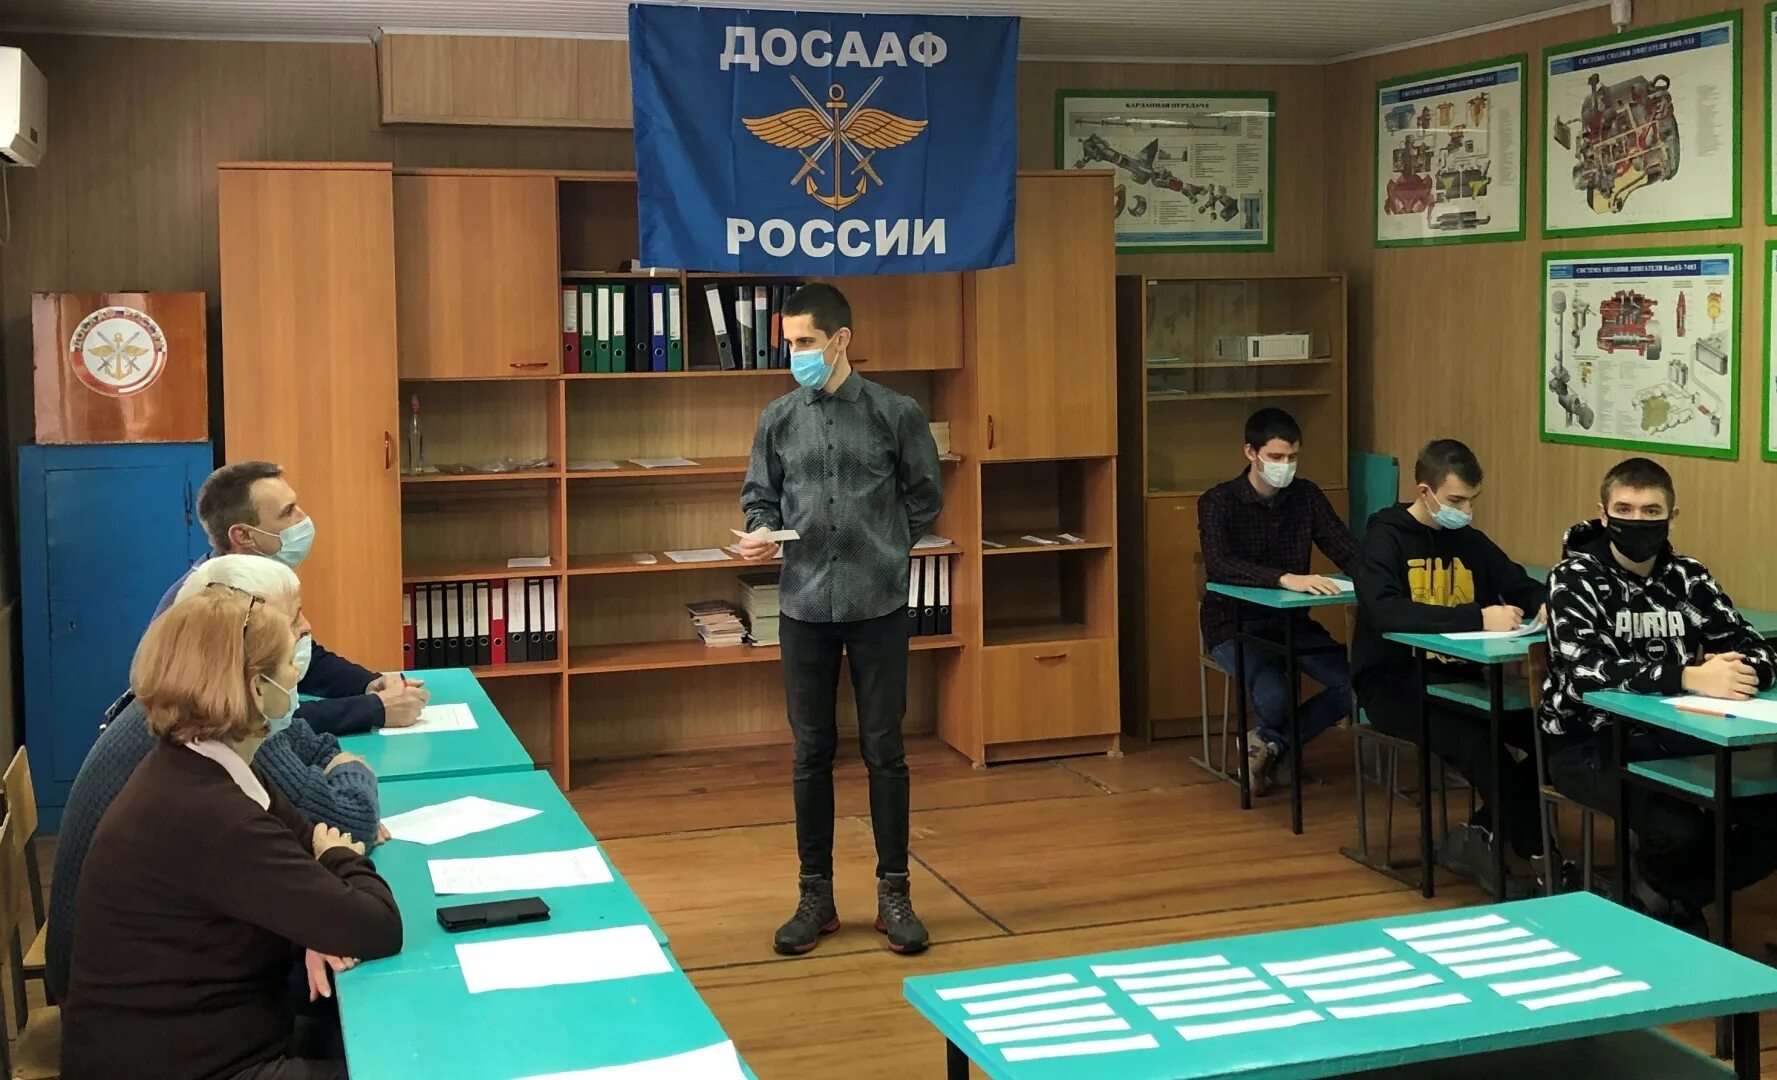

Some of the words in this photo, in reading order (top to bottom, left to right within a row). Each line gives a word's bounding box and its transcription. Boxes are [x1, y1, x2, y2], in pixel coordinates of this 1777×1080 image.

[720, 26, 947, 72] ДОСААФ
[727, 217, 947, 258] РОССИИ
[1615, 611, 1685, 638] PUMA
